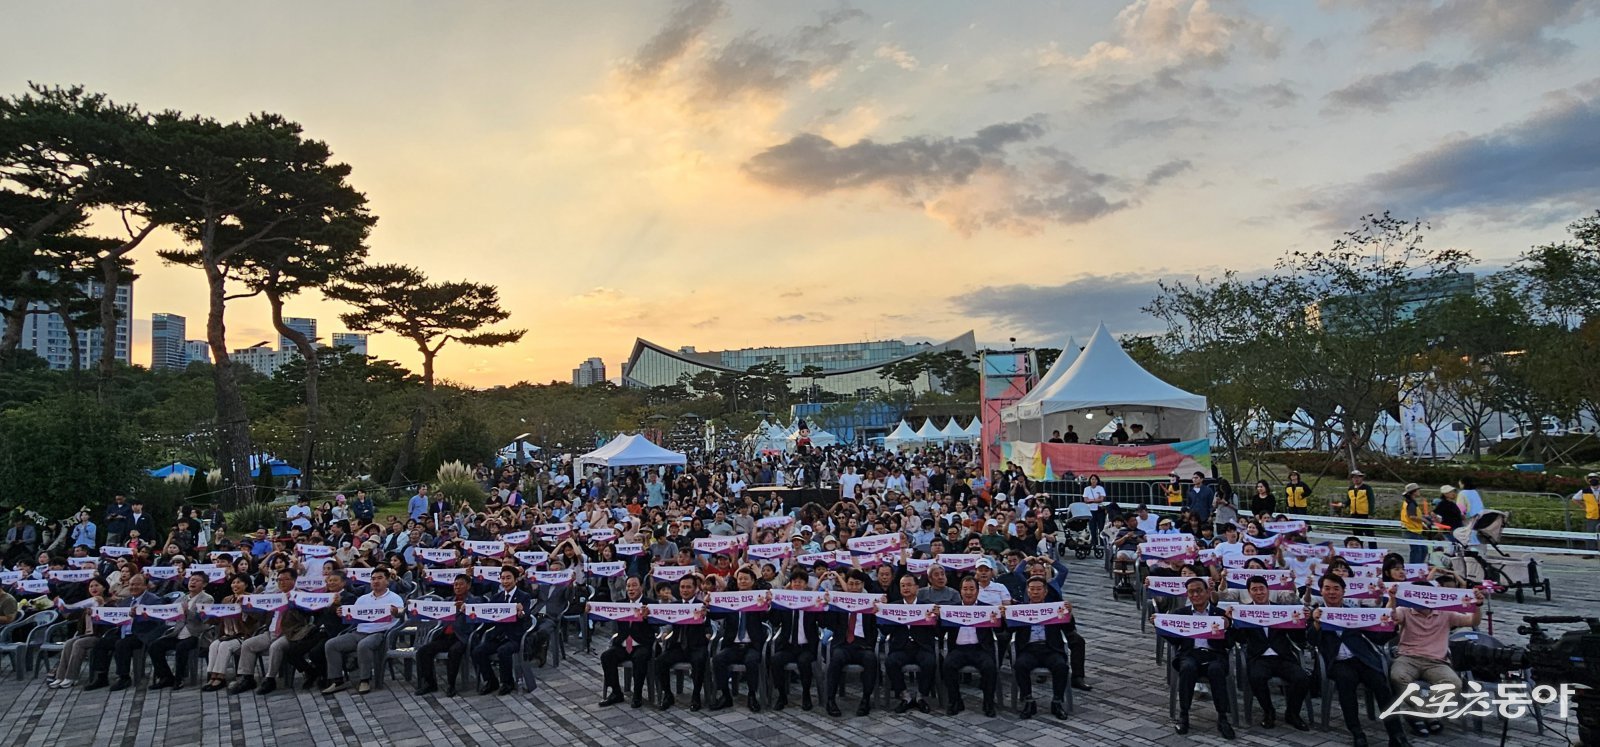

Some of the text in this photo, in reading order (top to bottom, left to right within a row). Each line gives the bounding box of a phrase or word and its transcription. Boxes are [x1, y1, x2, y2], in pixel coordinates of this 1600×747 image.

[1404, 590, 1437, 600] 품격있는
[1240, 610, 1270, 618] 품격있는
[1327, 613, 1358, 621] 품격있는
[1162, 620, 1190, 628] 품격있는
